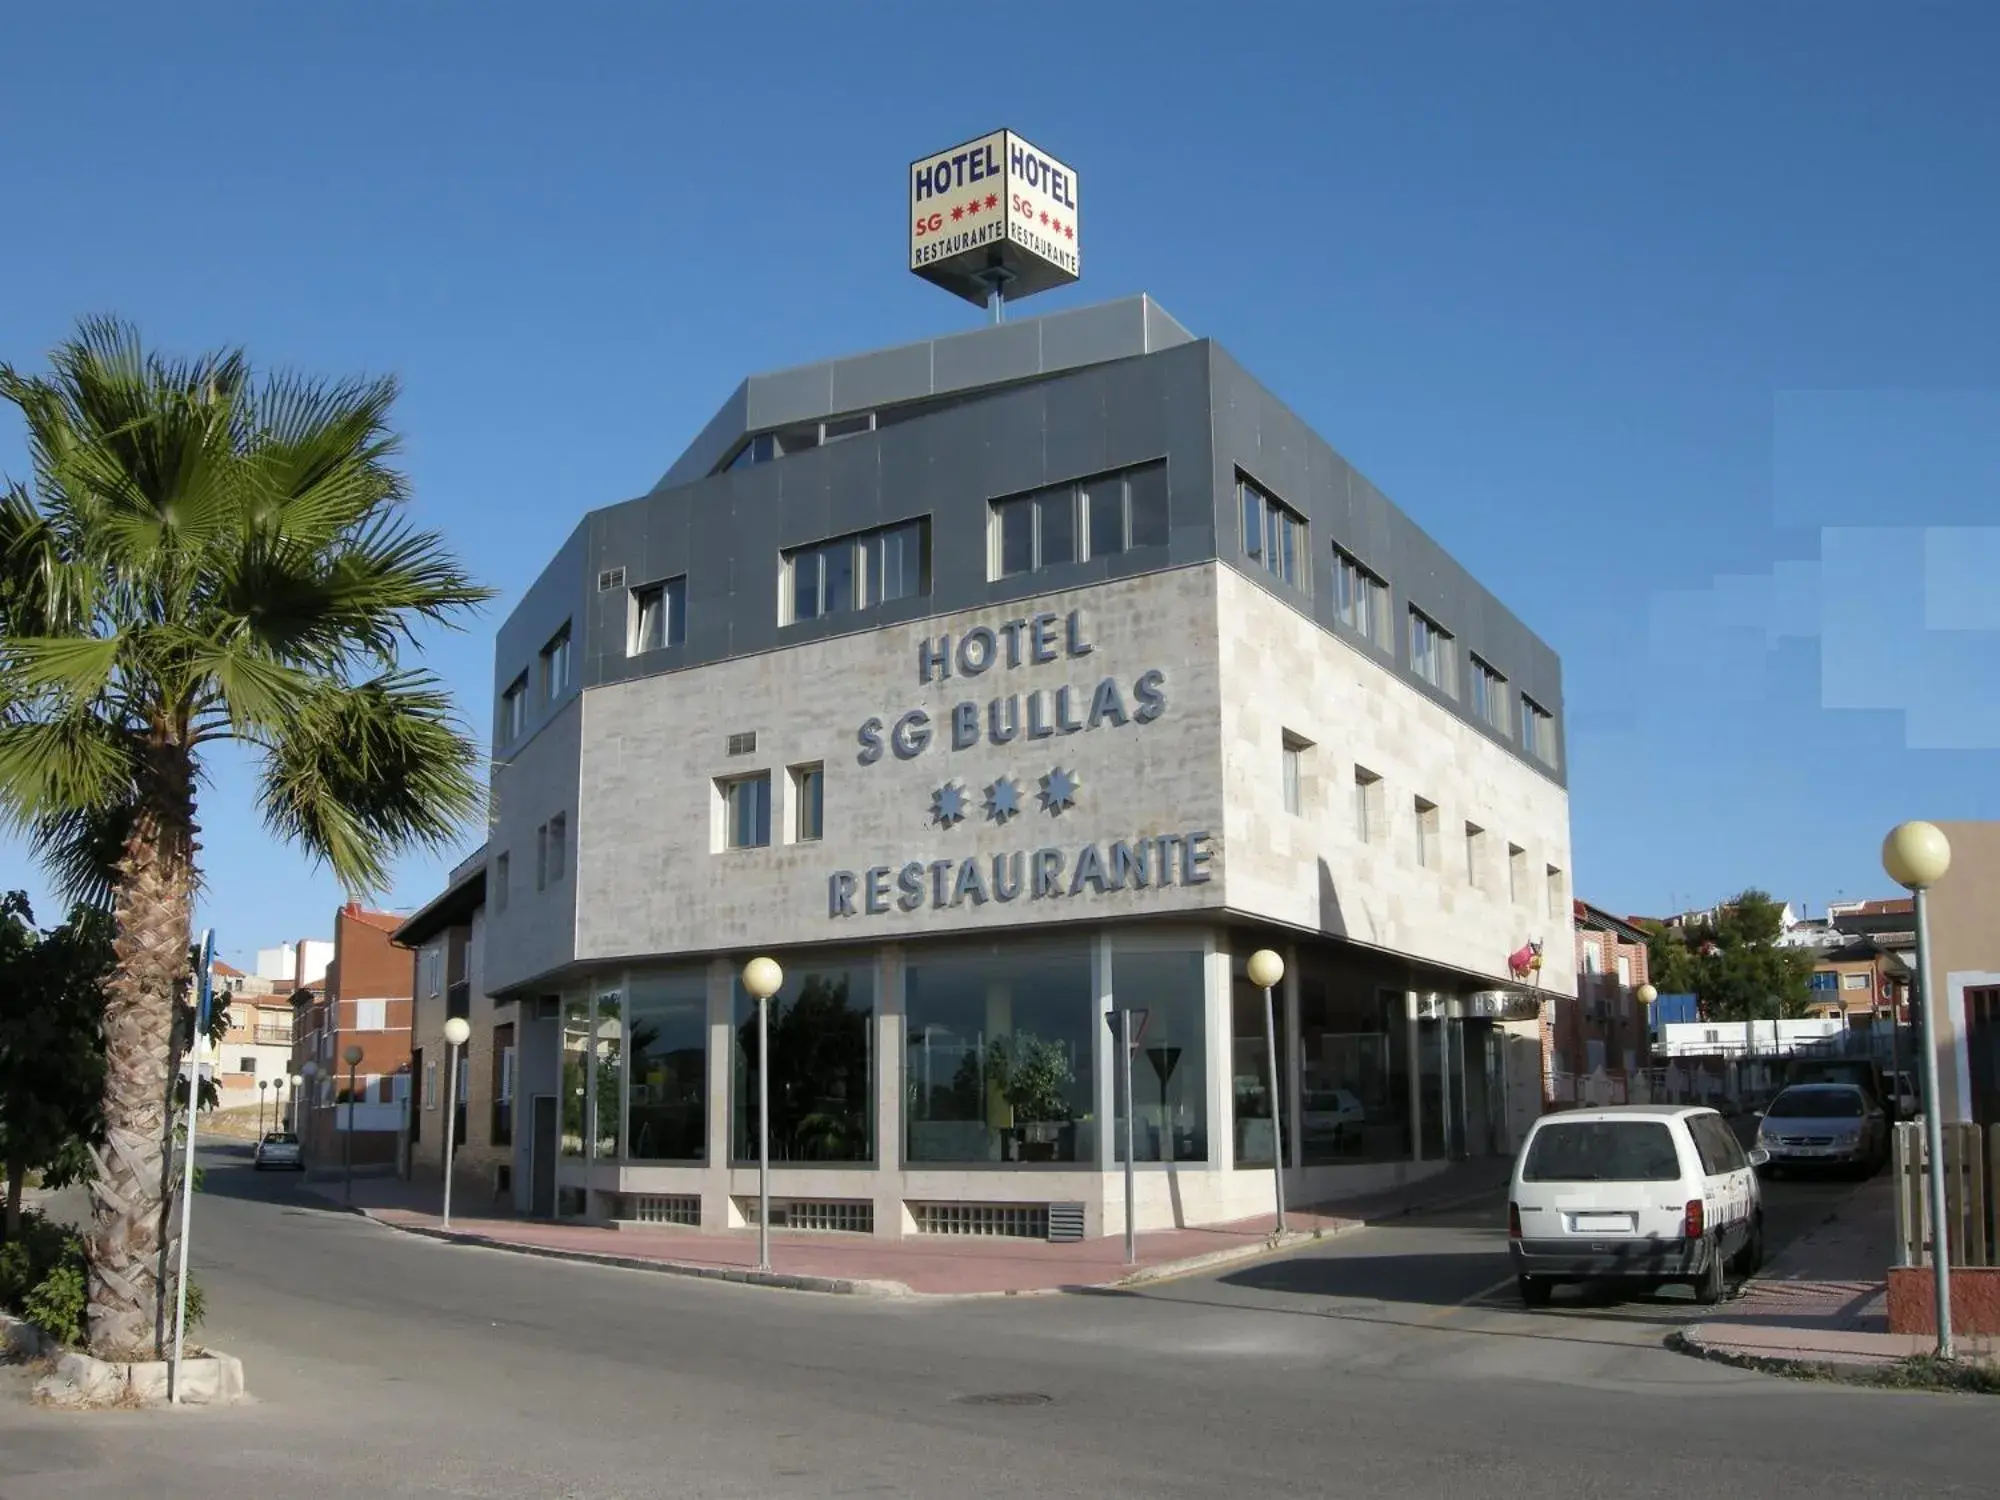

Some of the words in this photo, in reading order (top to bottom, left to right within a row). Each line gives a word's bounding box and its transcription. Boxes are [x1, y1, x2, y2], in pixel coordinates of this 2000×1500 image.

[916, 145, 1000, 202] HOTEL
[1011, 143, 1075, 210] HOTEL
[916, 213, 943, 236] SG
[1013, 193, 1034, 219] SG
[916, 220, 1003, 265] RESTAURANTE
[1011, 222, 1076, 272] RESTAURANTE
[919, 609, 1095, 685] HOTEL
[857, 709, 932, 766] SG
[952, 669, 1166, 751] BULLAS
[828, 831, 1213, 918] RESTAURANTE
